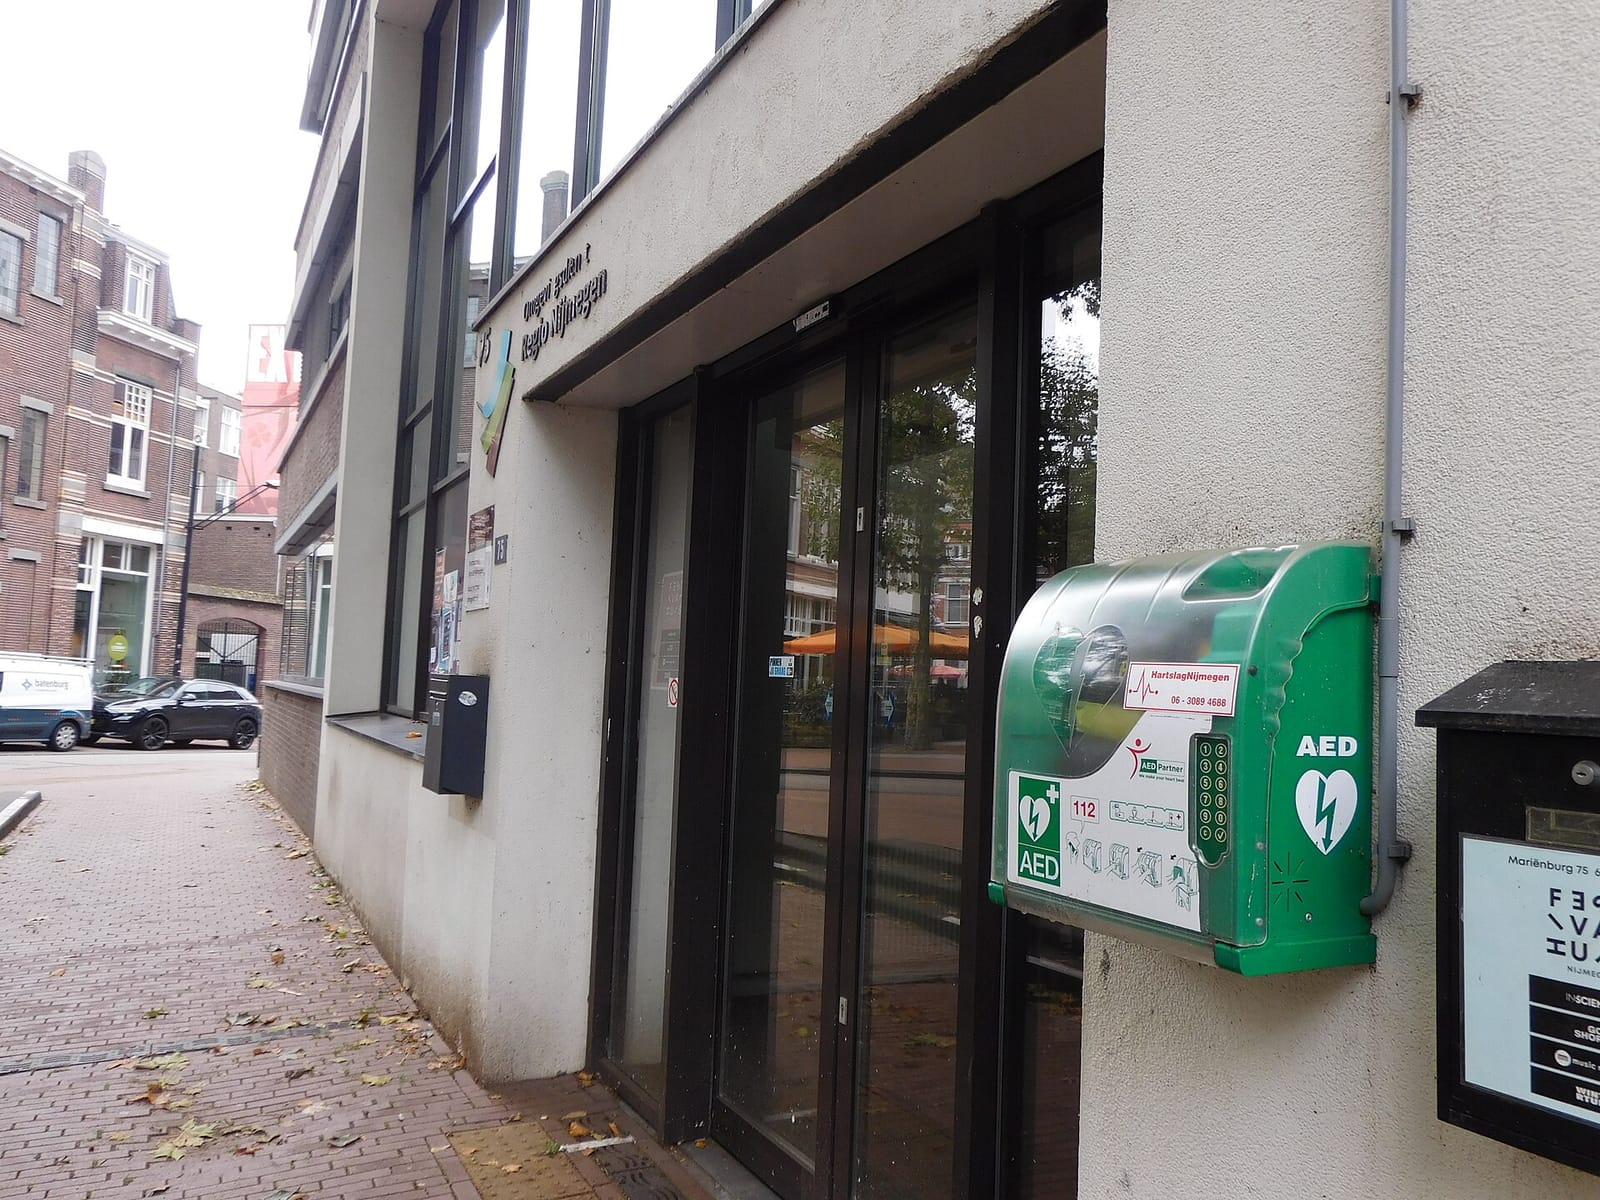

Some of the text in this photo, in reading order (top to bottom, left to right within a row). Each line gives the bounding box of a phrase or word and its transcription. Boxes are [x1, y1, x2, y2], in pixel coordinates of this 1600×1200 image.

[521, 269, 608, 361] Regio Nijmegen
[497, 539, 504, 560] 75
[1151, 670, 1230, 683] HartslagNijmegen
[1171, 696, 1181, 705] 06
[1187, 697, 1206, 706] 3089
[1207, 698, 1227, 707] 4688
[1296, 735, 1358, 757] AED
[1141, 761, 1184, 773] AED Partner
[1073, 800, 1096, 818] 112
[1020, 850, 1059, 881] AED
[1508, 855, 1573, 875] Mariënburg
[1576, 865, 1589, 875] 75
[1572, 1058, 1596, 1070] music
[1575, 1086, 1600, 1100] WIN
